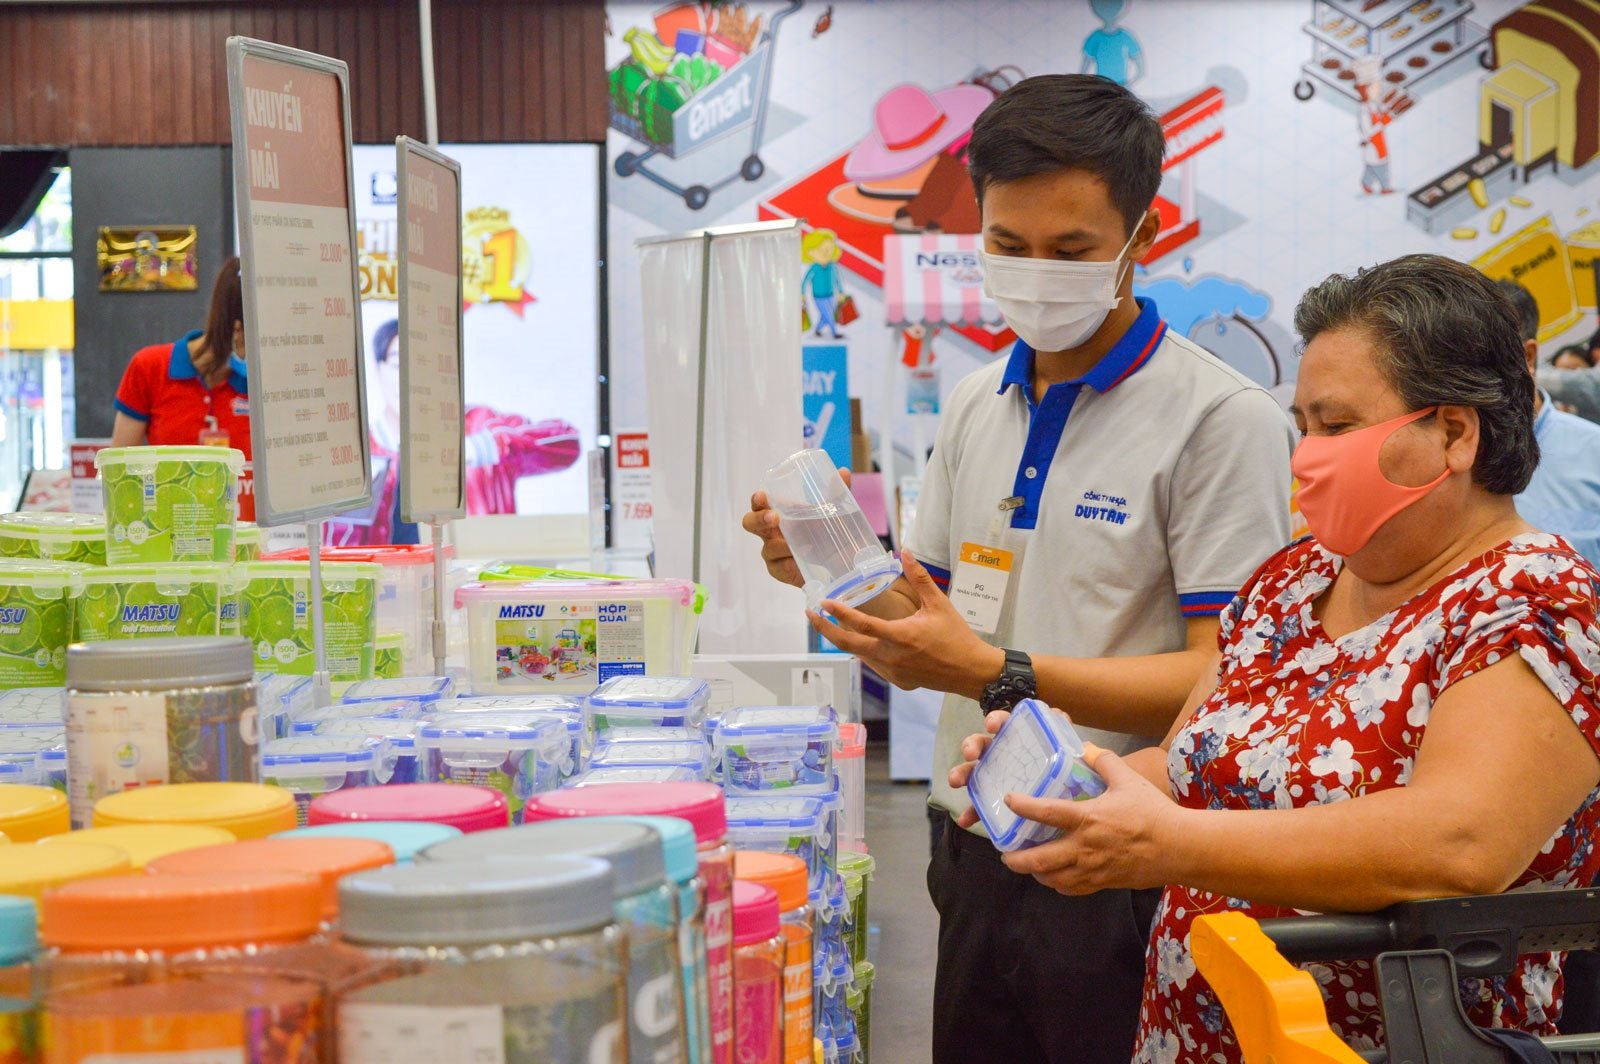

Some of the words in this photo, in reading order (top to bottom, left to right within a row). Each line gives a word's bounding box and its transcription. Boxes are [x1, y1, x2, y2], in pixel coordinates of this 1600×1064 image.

[245, 80, 303, 133] KHUYẾN
[688, 73, 751, 140] emart
[1511, 244, 1556, 279] Brand
[970, 551, 1001, 566] emart
[974, 583, 985, 592] PG
[121, 602, 181, 622] MATSU
[498, 604, 545, 619] MATSU
[598, 603, 627, 615] HỘP
[121, 623, 138, 633] Food
